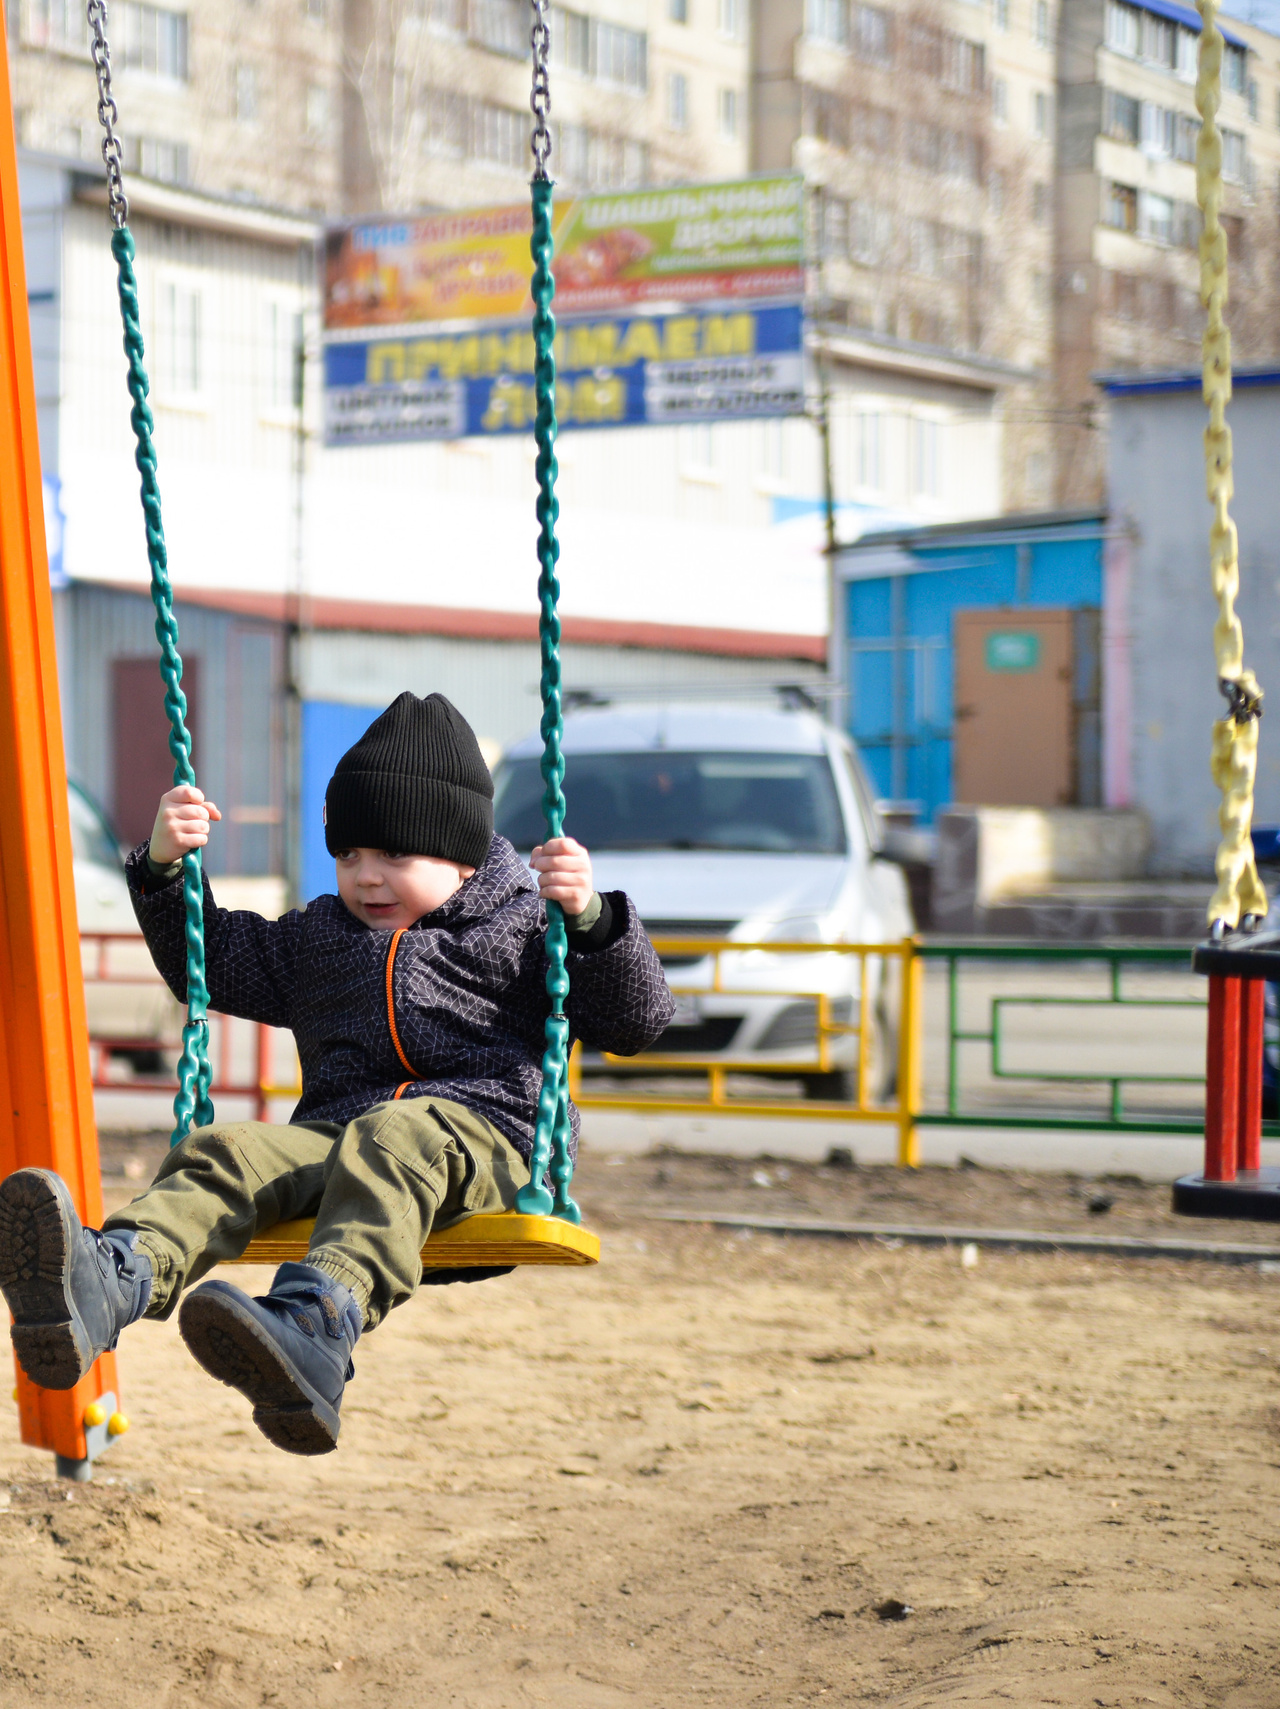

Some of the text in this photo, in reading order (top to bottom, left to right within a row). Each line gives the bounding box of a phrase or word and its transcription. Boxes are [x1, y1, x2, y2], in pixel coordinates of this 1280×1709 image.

[583, 182, 803, 229] ШАШЛЫЧНЫЙ
[673, 214, 801, 250] ДВОРИК
[368, 314, 754, 385] ПРИНИМАЕМ
